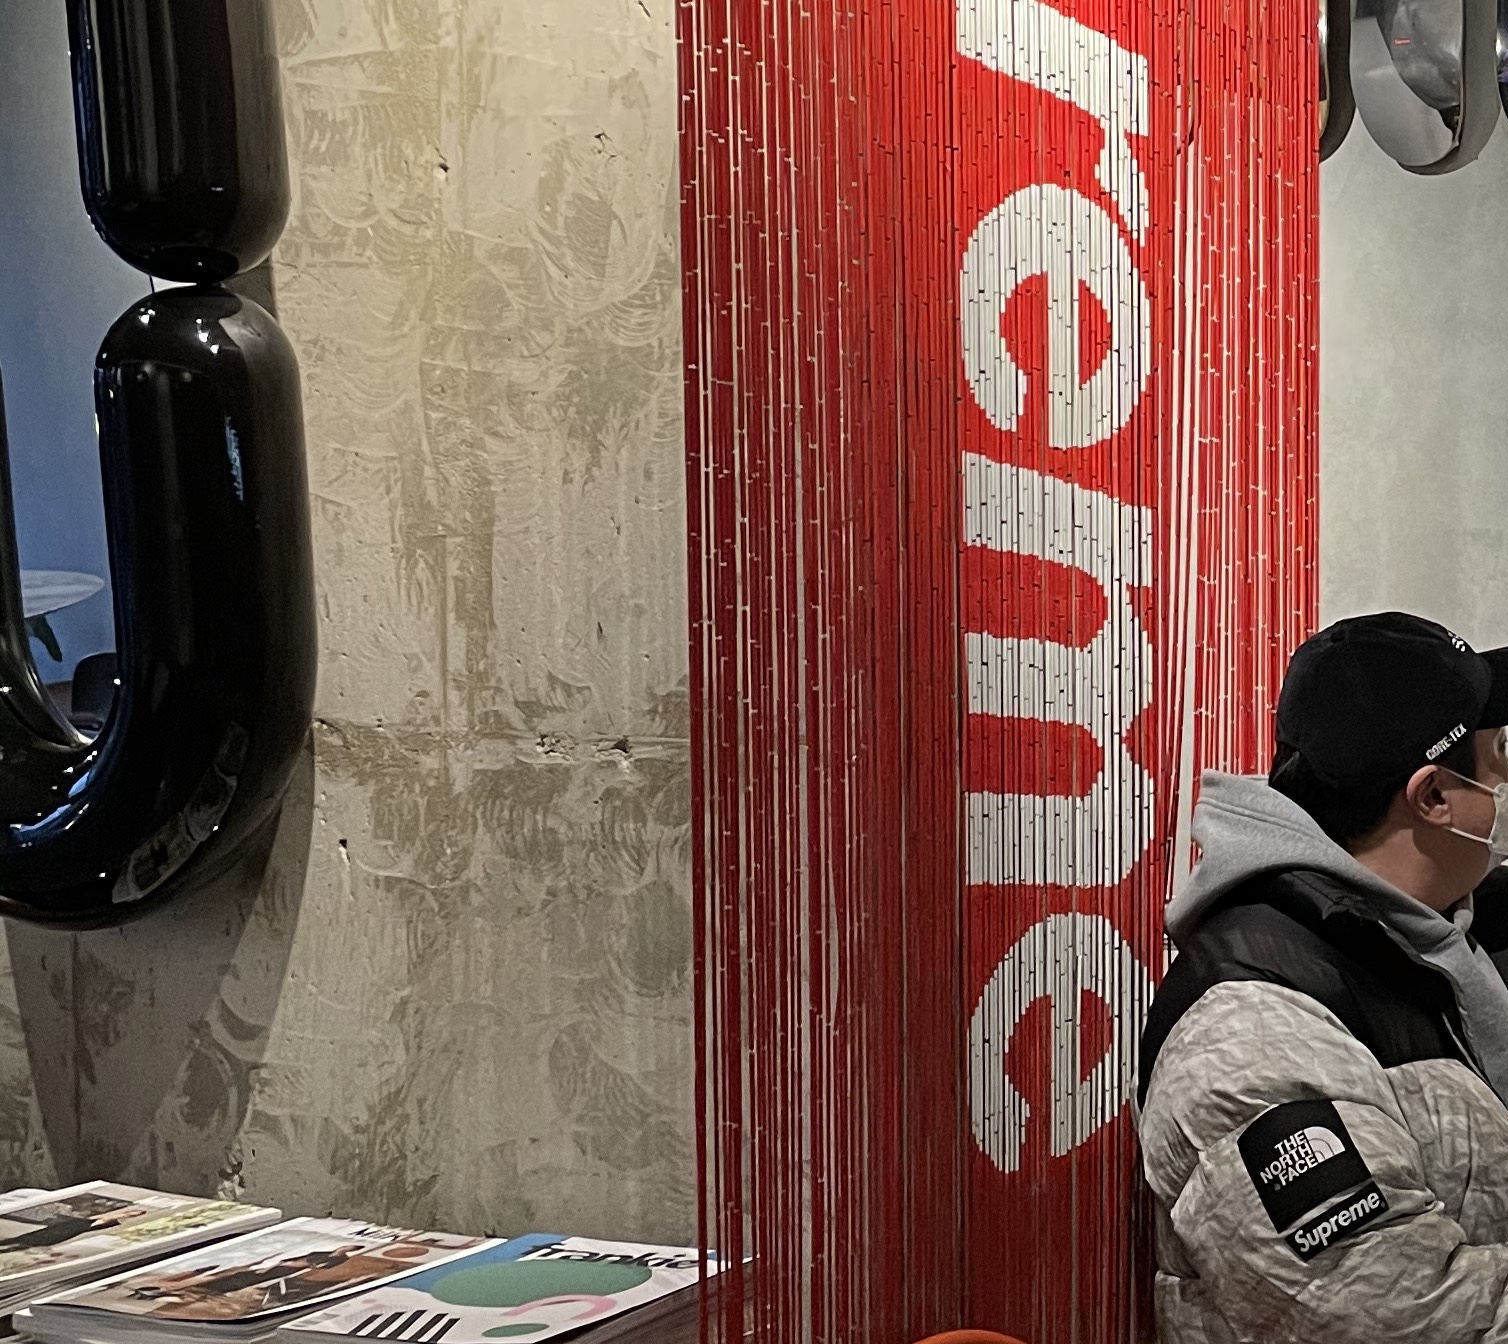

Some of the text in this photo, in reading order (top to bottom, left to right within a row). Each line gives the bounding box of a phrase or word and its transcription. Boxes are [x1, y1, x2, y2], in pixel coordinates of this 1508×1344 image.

[1425, 722, 1467, 761] GORE-TEX
[1273, 1130, 1308, 1156] THE
[1259, 1142, 1313, 1184] NORTH
[1278, 1156, 1319, 1186] FACE
[1294, 1192, 1381, 1253] Supreme
